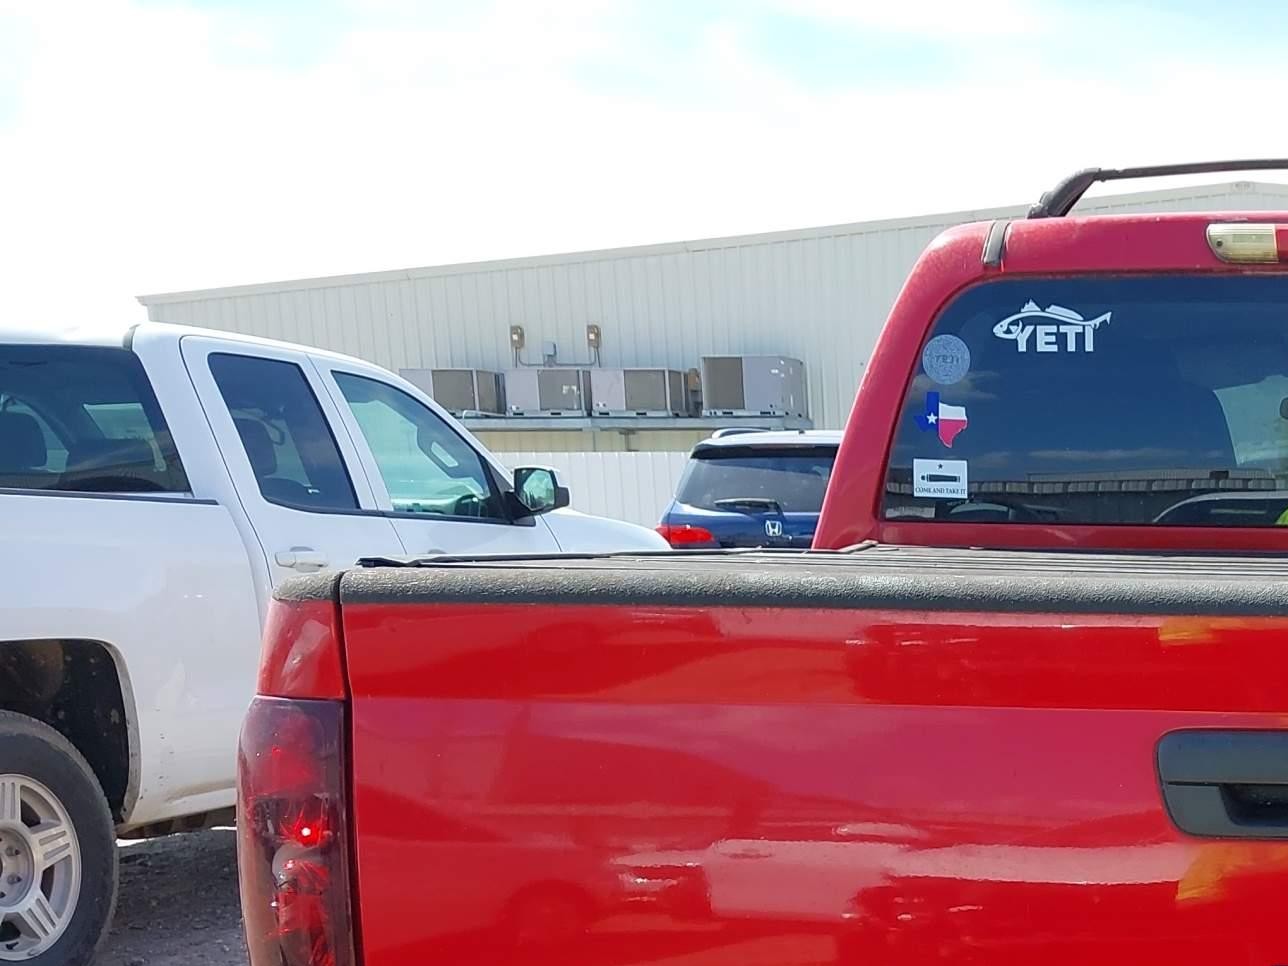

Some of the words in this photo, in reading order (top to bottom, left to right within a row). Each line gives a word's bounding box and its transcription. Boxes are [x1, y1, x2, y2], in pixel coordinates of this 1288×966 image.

[1015, 325, 1094, 353] YETI
[915, 486, 931, 494] COME
[945, 487, 960, 495] TAKE
